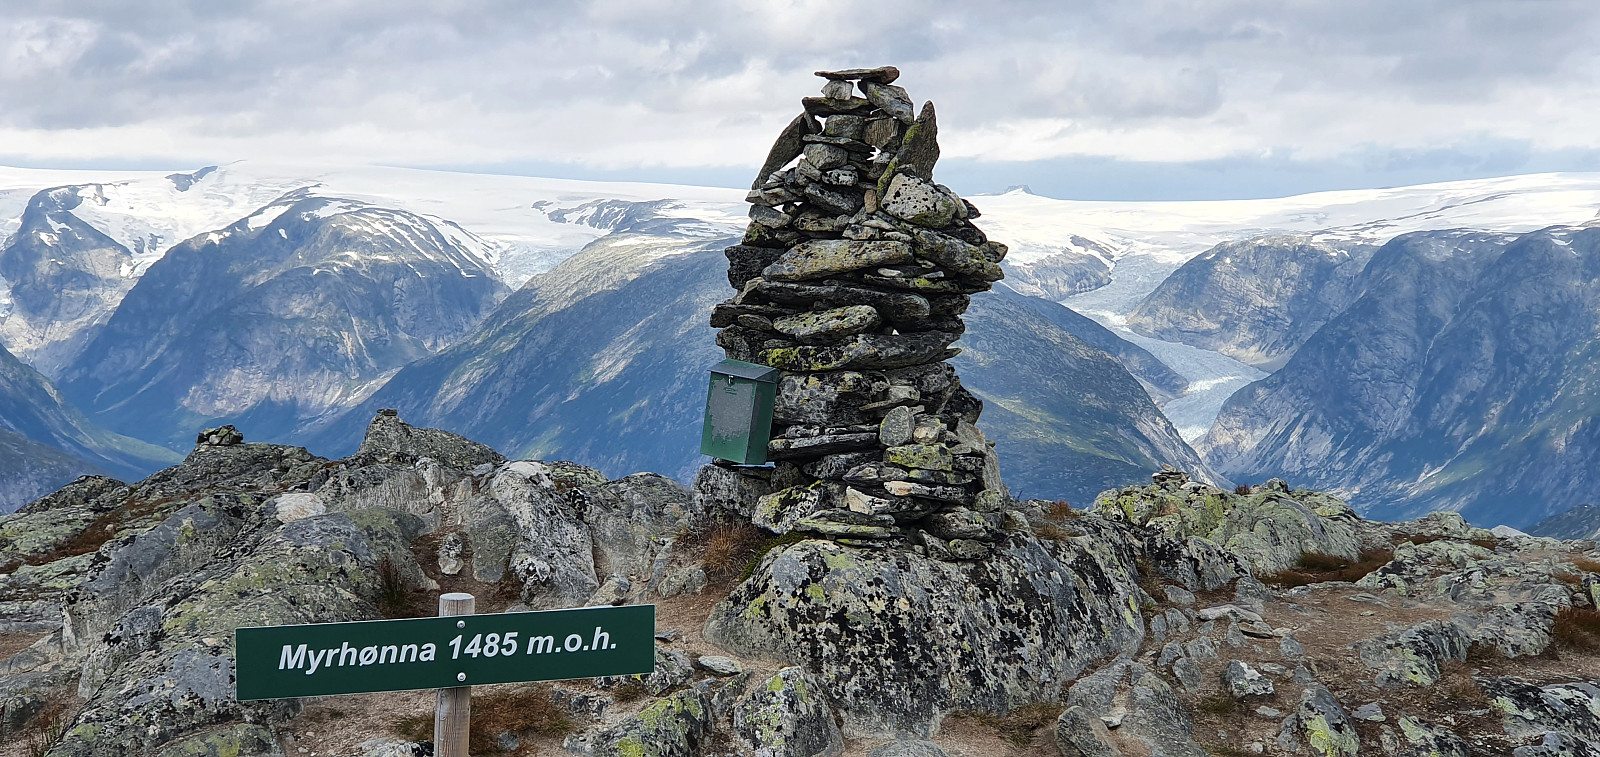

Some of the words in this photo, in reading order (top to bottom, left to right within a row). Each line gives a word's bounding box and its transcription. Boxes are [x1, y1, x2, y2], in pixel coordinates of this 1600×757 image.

[278, 641, 437, 675] Myrhønna
[448, 631, 519, 660] 1485
[526, 626, 617, 655] m.o.h.
